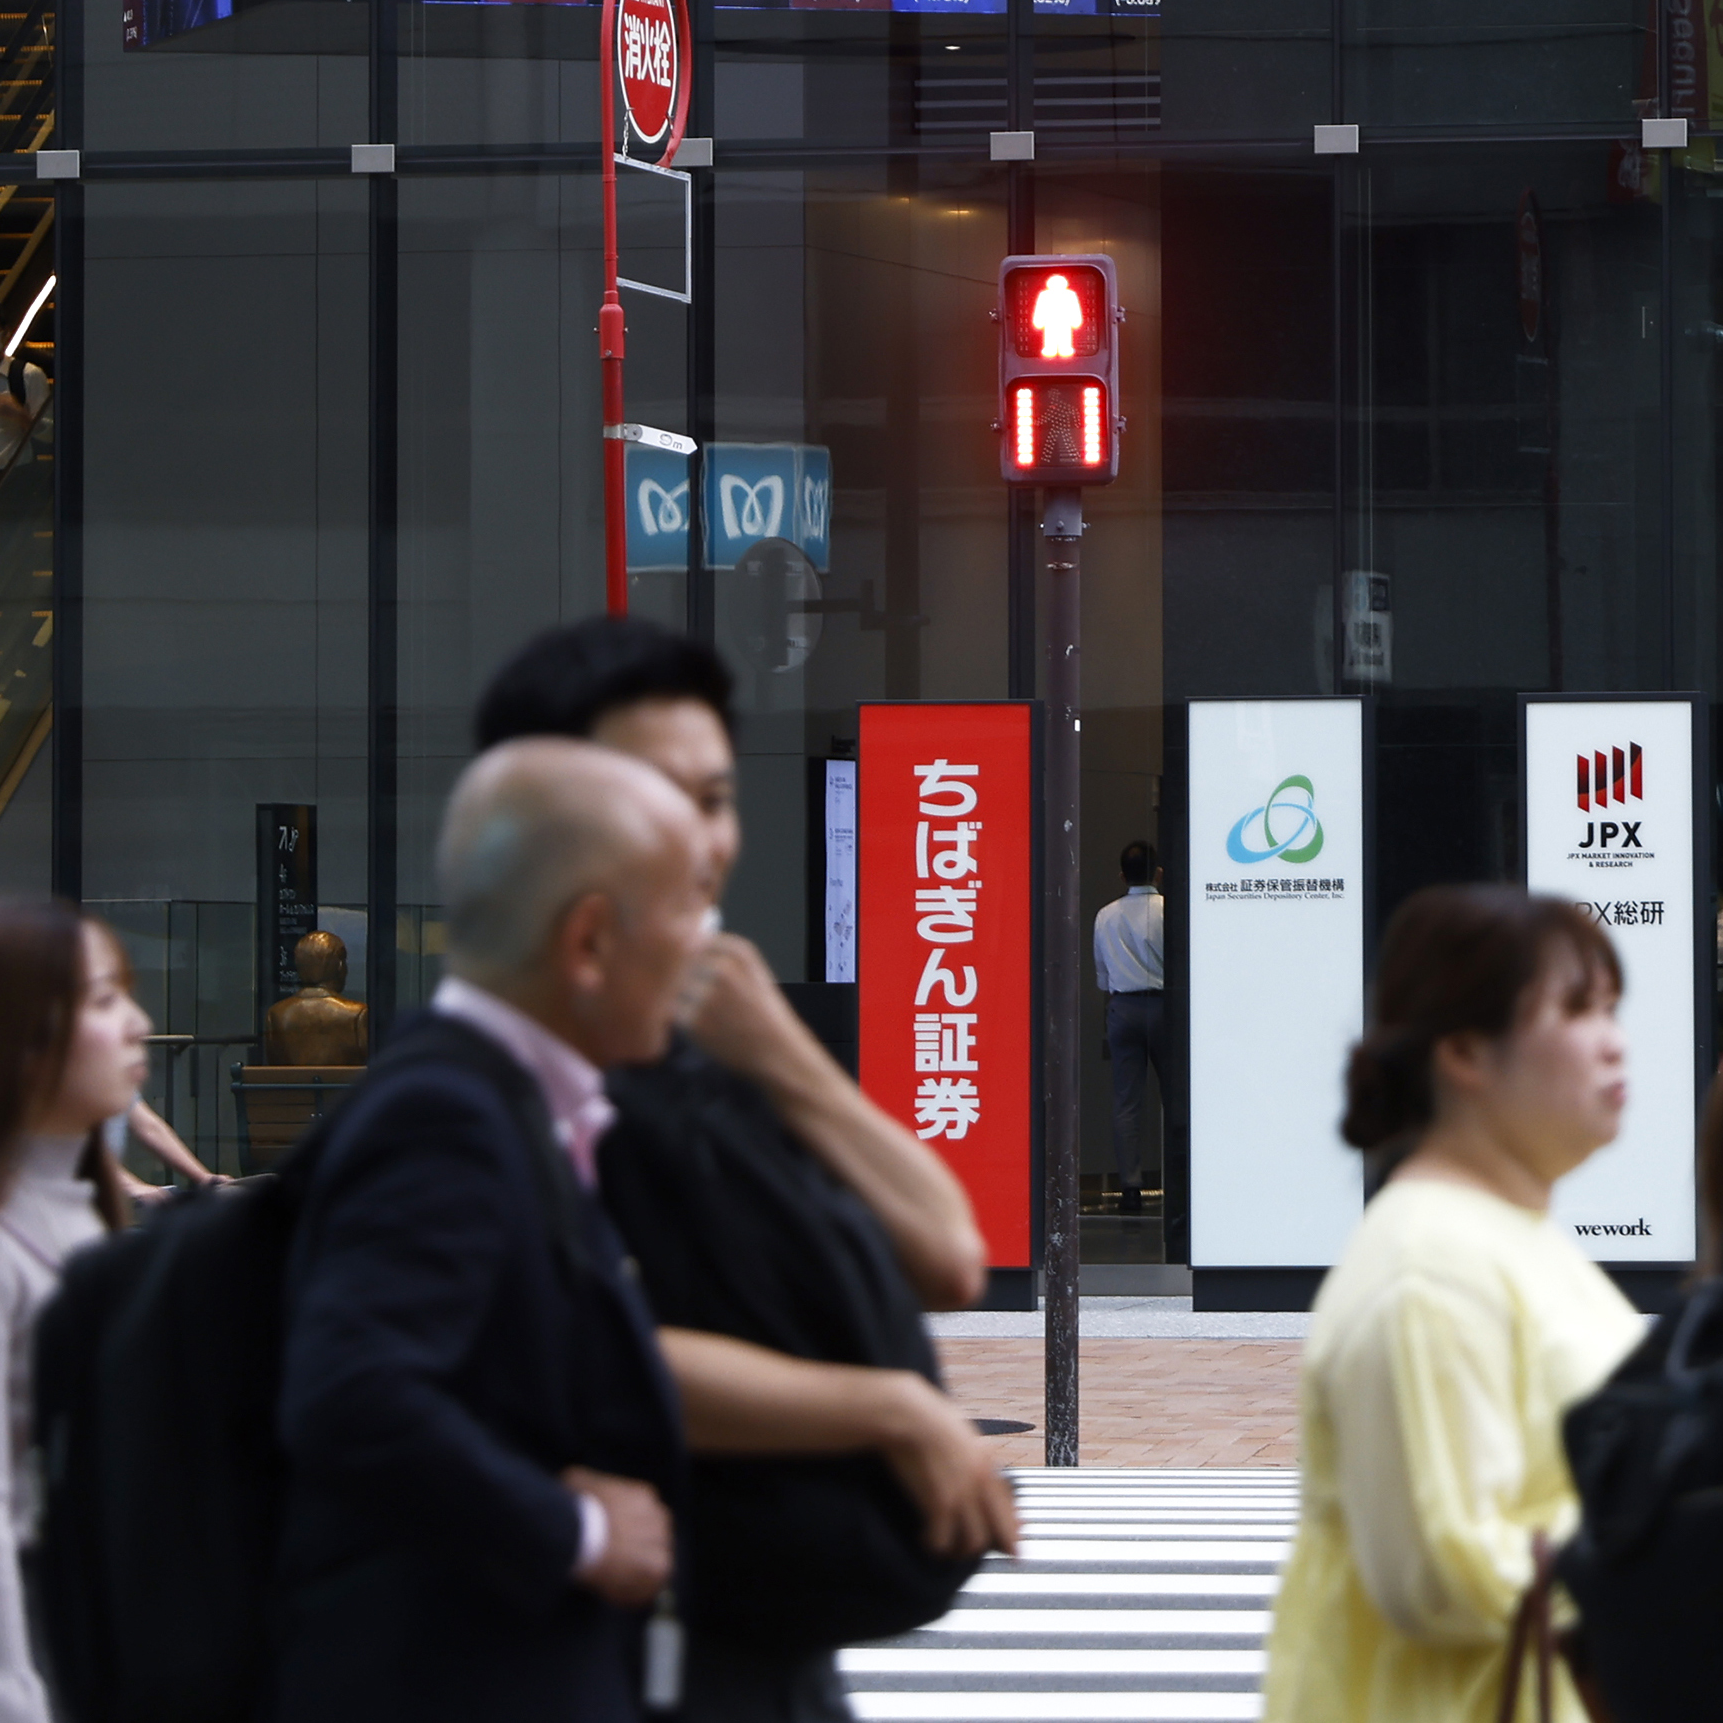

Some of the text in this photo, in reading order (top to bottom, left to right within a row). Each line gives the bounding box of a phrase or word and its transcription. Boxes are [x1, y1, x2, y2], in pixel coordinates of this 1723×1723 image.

[624, 12, 672, 88] 消火栓
[1578, 821, 1643, 848] JPX
[1205, 879, 1345, 892] 株式会社 証券保管振替機構
[1205, 893, 1226, 901] Japan
[1263, 893, 1302, 901] Depository
[1304, 892, 1330, 900] Center,
[1576, 900, 1665, 926] PX総研
[914, 759, 983, 1140] ちばぎん証券
[1574, 1217, 1653, 1236] wework
